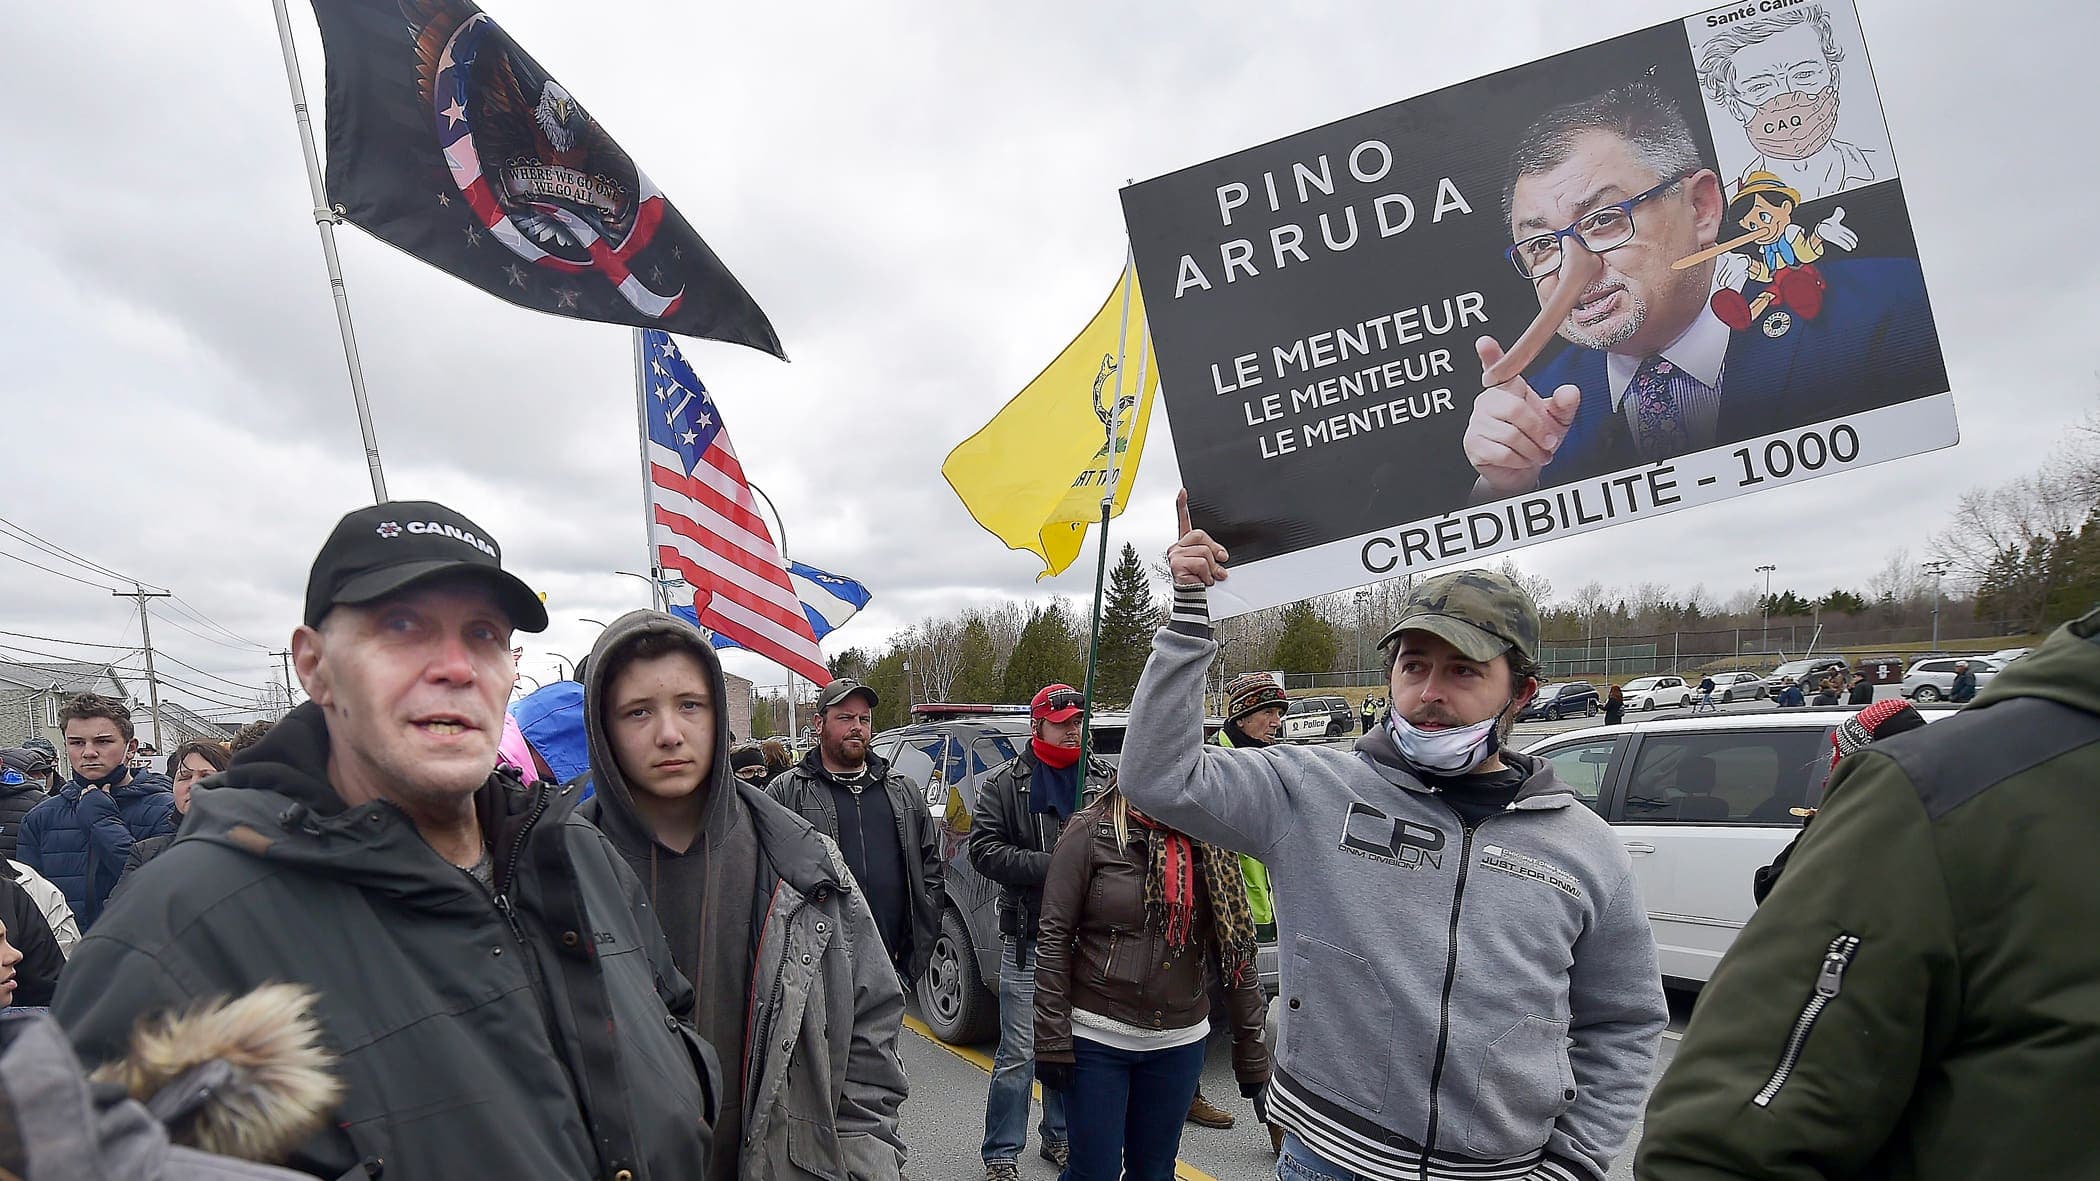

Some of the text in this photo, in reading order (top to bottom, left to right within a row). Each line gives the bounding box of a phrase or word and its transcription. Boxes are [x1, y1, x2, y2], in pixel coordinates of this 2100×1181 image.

[1706, 4, 1756, 28] Santé
[1763, 115, 1803, 134] CAQ
[509, 168, 619, 201] WHERE WE GO ONE
[535, 181, 595, 203] WE GO ALL
[1216, 139, 1394, 226] PINO
[1174, 177, 1473, 299] ARRUDA
[1210, 290, 1490, 395] LE MENTEUR
[1243, 347, 1454, 426] LE MENTEUR
[1258, 387, 1455, 460] LE MENTEUR
[1361, 459, 1683, 575] CRÉDIBILITÉ
[1732, 423, 1861, 489] 1000
[1303, 719, 1325, 729] Police
[1338, 844, 1366, 858] DNM
[1481, 856, 1517, 871] JUST
[1519, 866, 1546, 881] FOR
